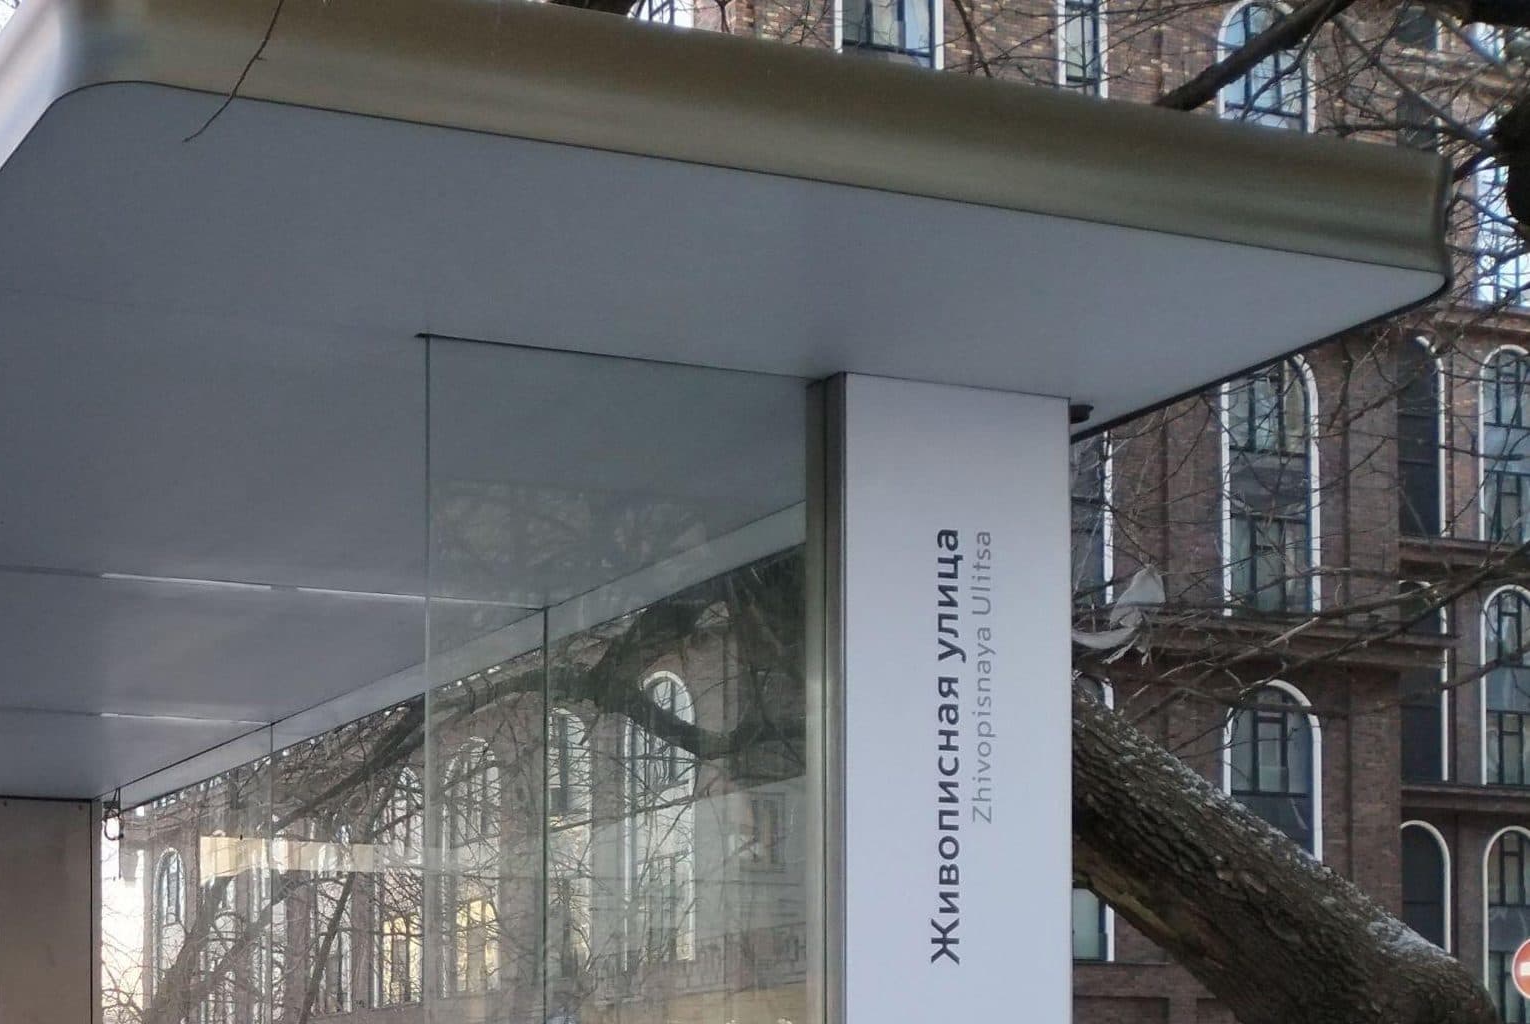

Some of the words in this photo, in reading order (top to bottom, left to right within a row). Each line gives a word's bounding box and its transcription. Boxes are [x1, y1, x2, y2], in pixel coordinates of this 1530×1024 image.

[936, 528, 967, 664] улица
[972, 530, 992, 615] Ulitsa
[972, 626, 996, 824] Zhivopisnaya
[930, 676, 960, 966] Живописная
